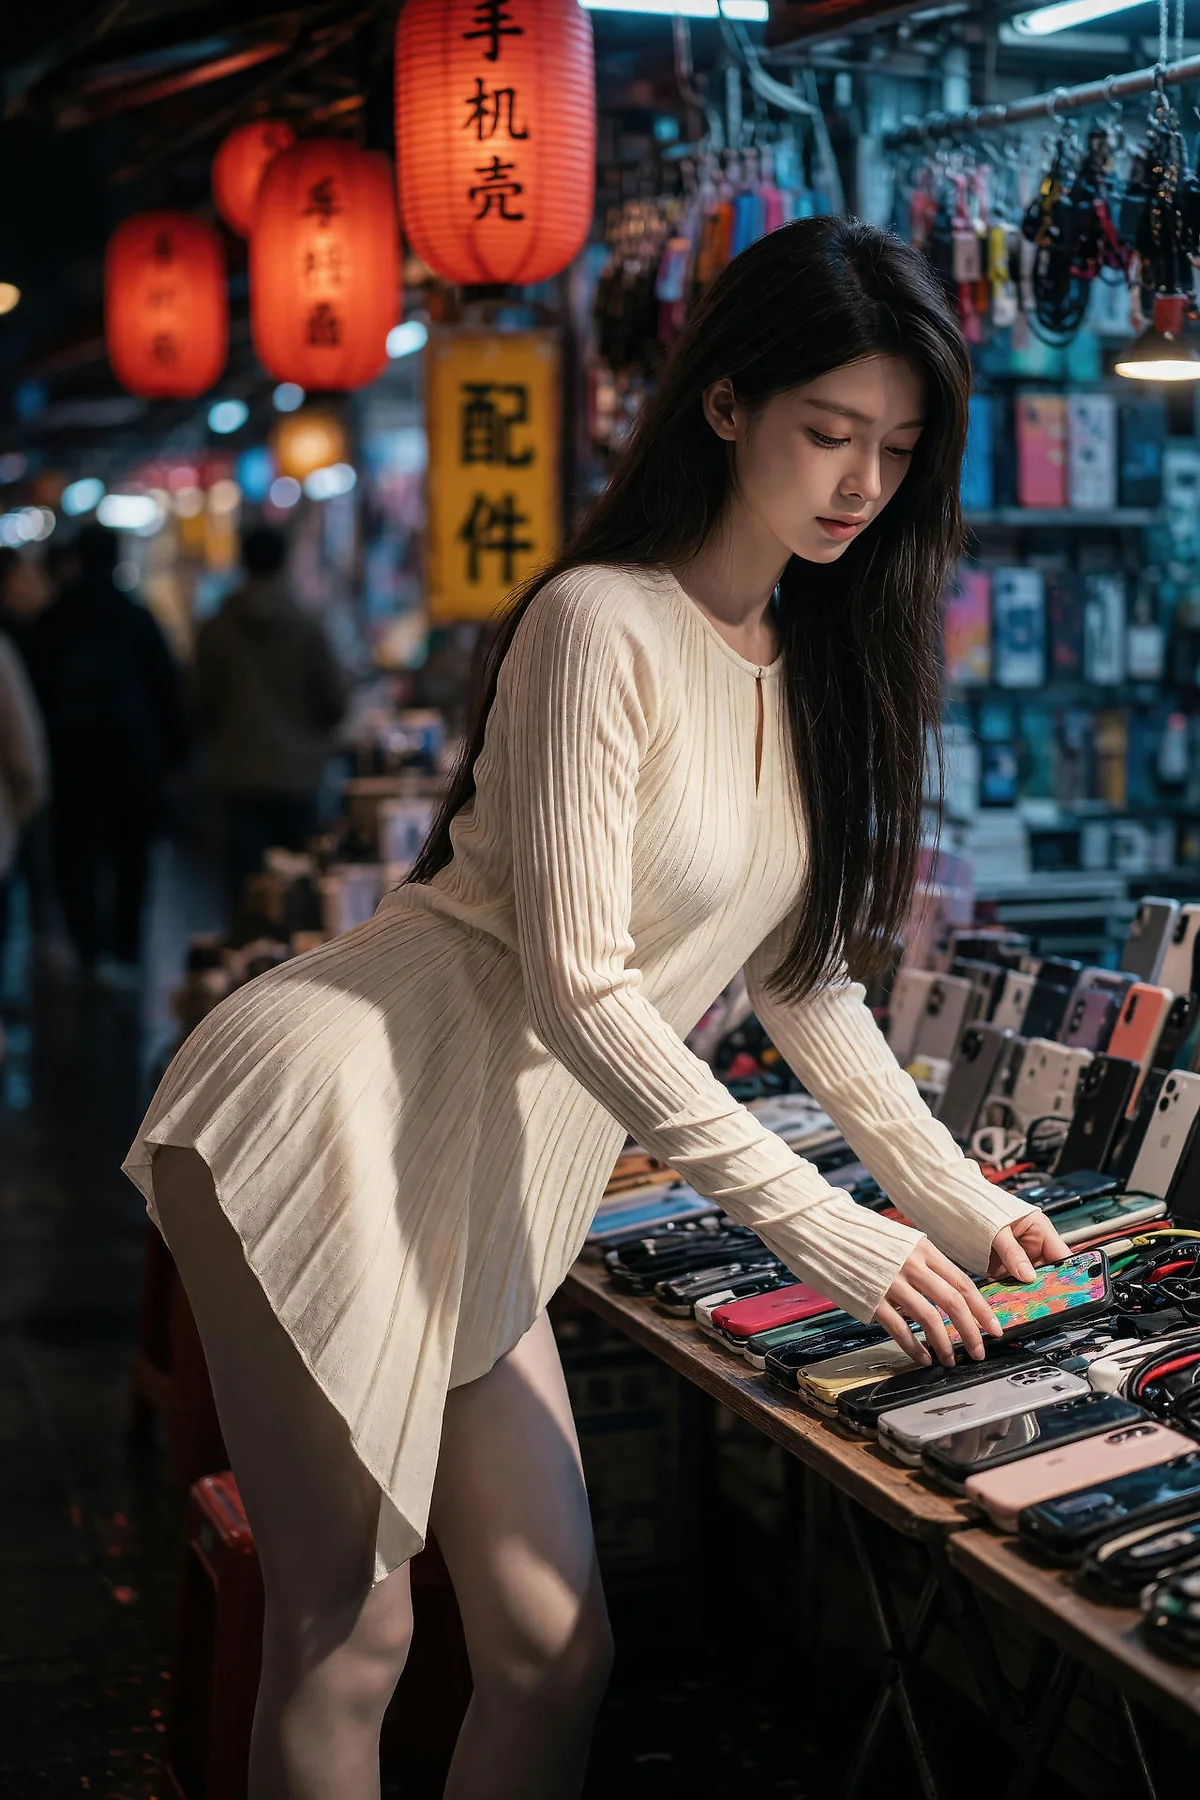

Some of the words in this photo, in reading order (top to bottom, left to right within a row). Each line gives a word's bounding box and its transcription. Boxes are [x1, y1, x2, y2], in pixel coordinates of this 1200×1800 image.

[462, 0, 529, 221] 手机壳
[458, 382, 534, 585] 配件
